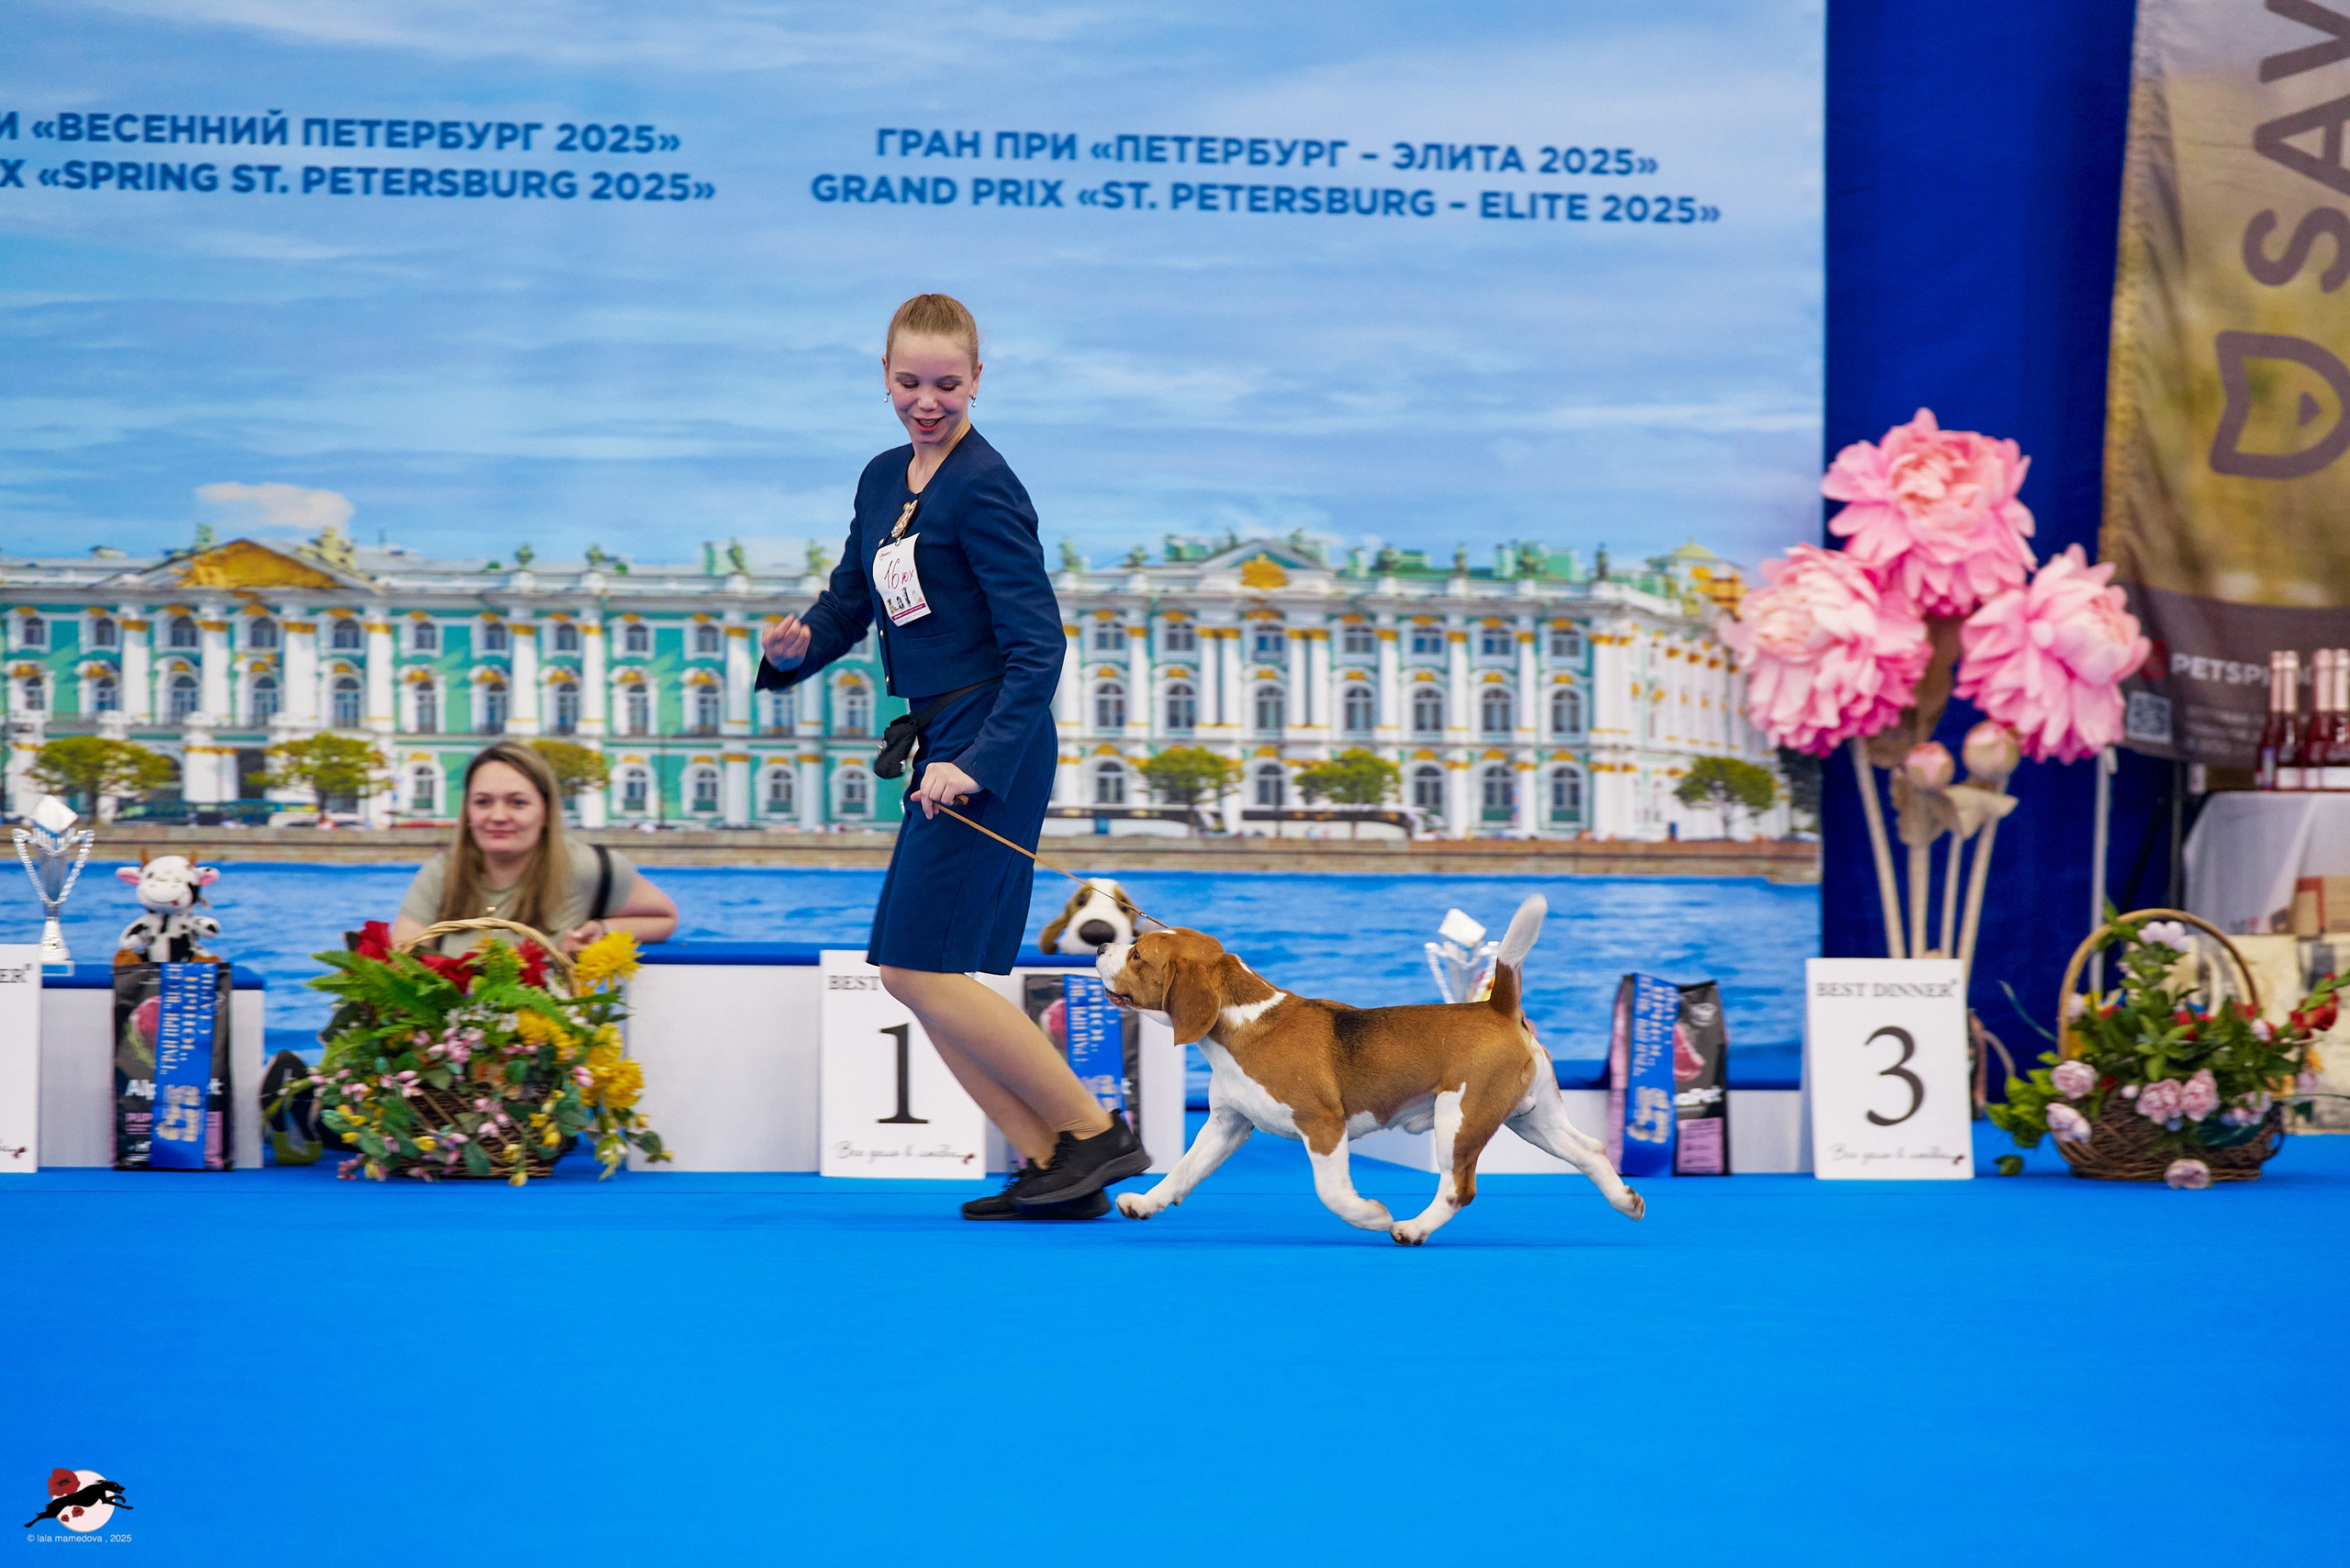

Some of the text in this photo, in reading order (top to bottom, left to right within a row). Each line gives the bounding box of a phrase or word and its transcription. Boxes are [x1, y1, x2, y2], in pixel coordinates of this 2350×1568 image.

[31, 109, 288, 146] «ВЕСЕННИЙ
[302, 117, 543, 151] ПЕТЕРБУРГ
[555, 122, 681, 153] 2025»
[876, 128, 981, 159] ГРАН
[995, 131, 1078, 161] ПРИ
[1090, 134, 1348, 167] «ПЕТЕРБУРГ
[1392, 141, 1526, 173] ЭЛИТА
[1538, 146, 1659, 175] 2025»
[38, 160, 219, 193] «SPRING
[231, 163, 288, 195] ST.
[302, 165, 578, 199] PETERSBURG
[589, 170, 716, 201] 2025»
[811, 174, 958, 205] GRAND
[971, 177, 1065, 207] PRIX
[1077, 181, 1157, 209] «ST.
[1170, 183, 1436, 217] PETERSBURG
[1480, 191, 1589, 221] ELITE
[1601, 195, 1721, 224] 2025»
[884, 558, 901, 589] 16
[828, 975, 880, 991] BEST
[1817, 982, 1866, 997] BEST
[877, 1023, 930, 1125] 1
[1864, 1025, 1925, 1126] 3
